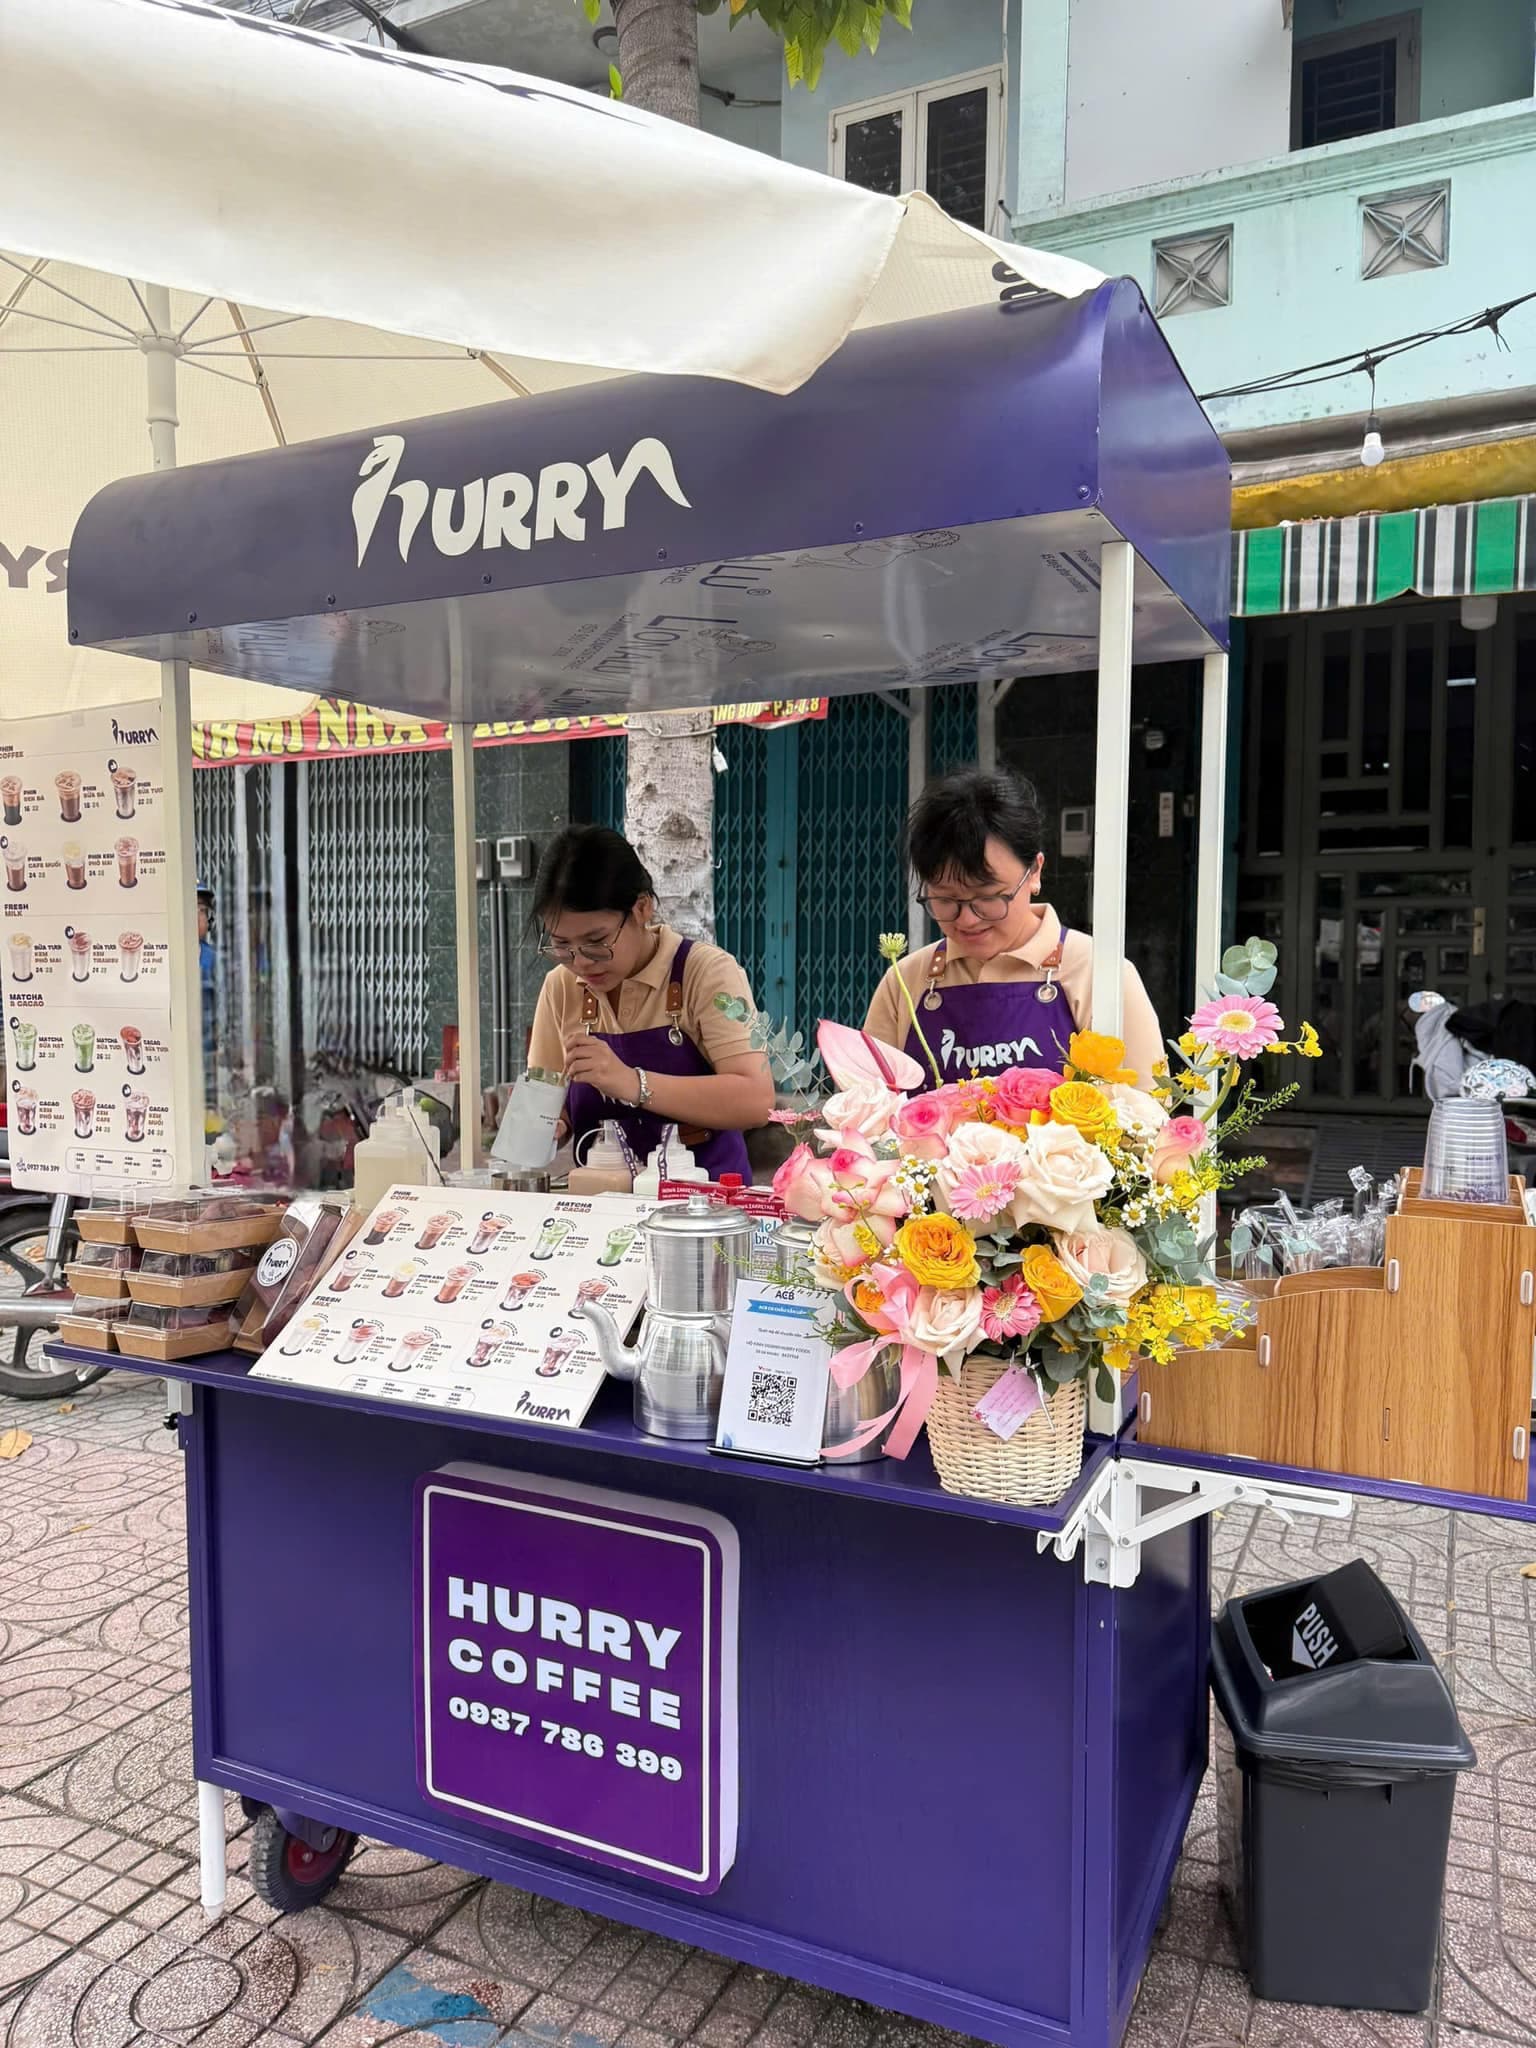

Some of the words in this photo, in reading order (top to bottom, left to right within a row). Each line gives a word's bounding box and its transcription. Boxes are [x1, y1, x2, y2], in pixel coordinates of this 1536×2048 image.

[775, 1290, 795, 1300] ACB
[448, 1576, 682, 1670] HURRY
[1295, 1602, 1339, 1669] PUSH
[448, 1638, 681, 1730] COFFEE
[449, 1697, 530, 1736] 0937
[541, 1720, 604, 1758] 786
[615, 1743, 682, 1781] 399
